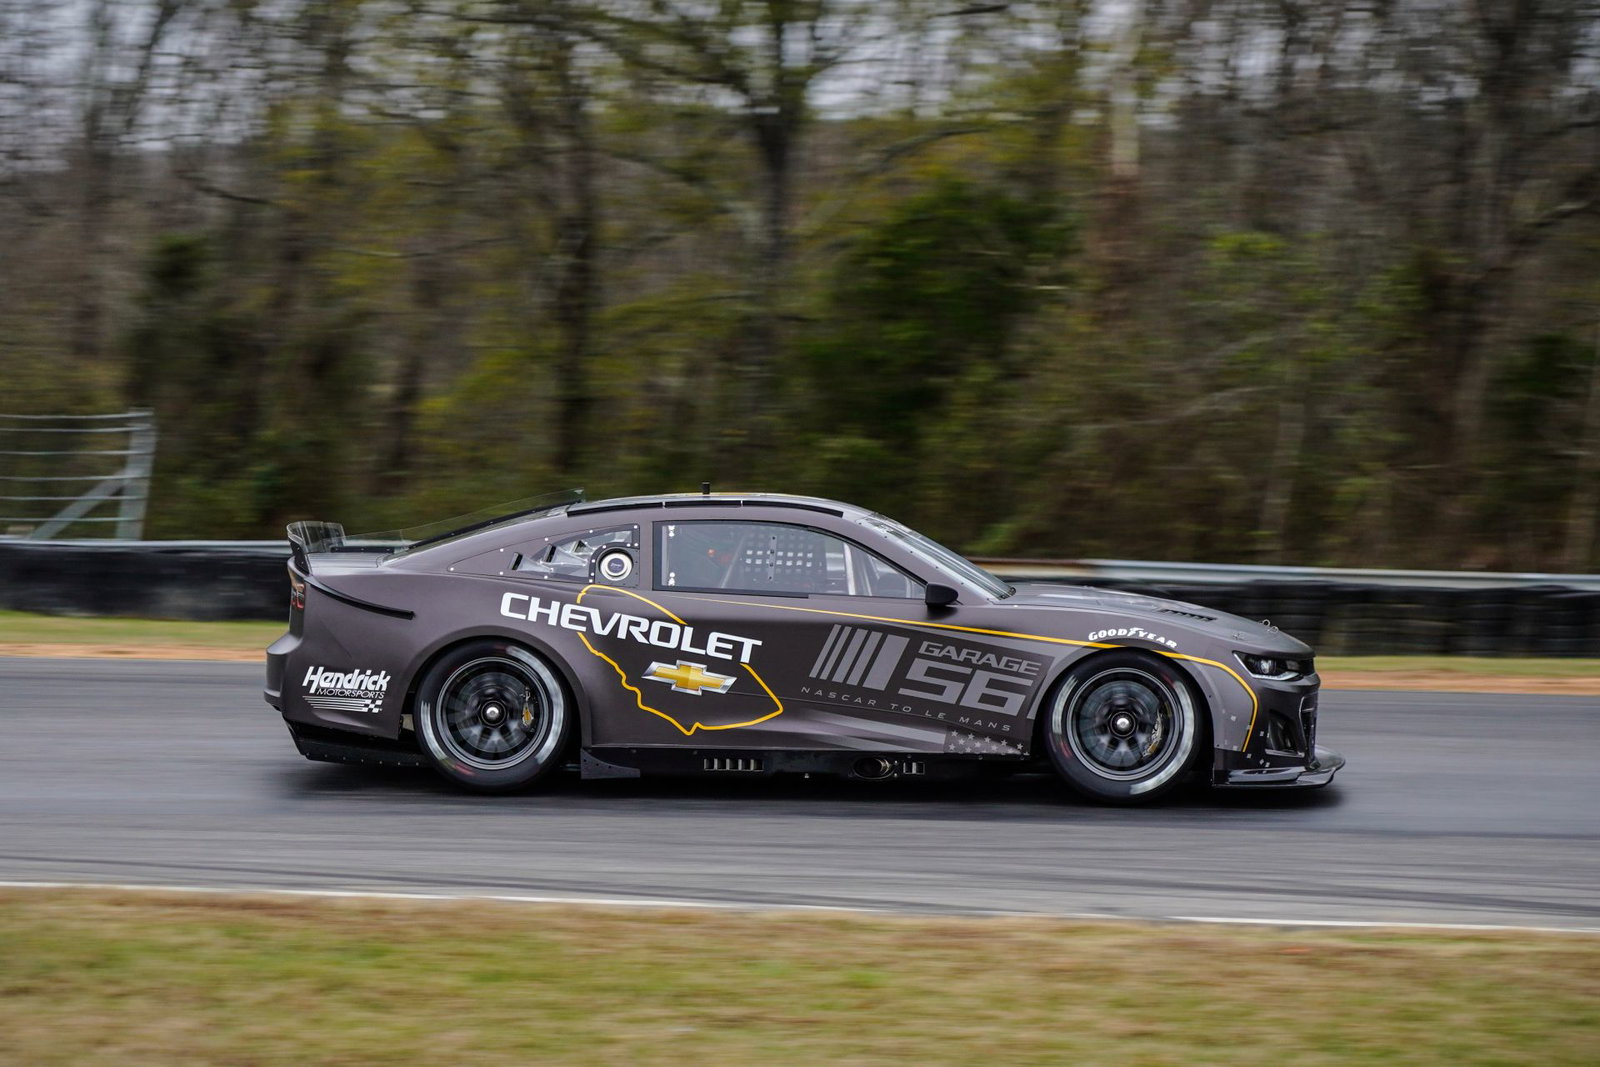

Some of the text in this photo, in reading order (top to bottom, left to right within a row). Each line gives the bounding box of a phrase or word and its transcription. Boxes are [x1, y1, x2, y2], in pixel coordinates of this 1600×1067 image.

[500, 592, 763, 664] CHEVROLET
[1088, 627, 1177, 648] GOODYEAR
[918, 640, 1042, 676] GARAGE
[302, 666, 391, 693] Hendrick
[317, 688, 386, 699] MOTORSPORTS
[898, 657, 1034, 717] 56
[801, 686, 1012, 732] NASCAR TO LE MANS
